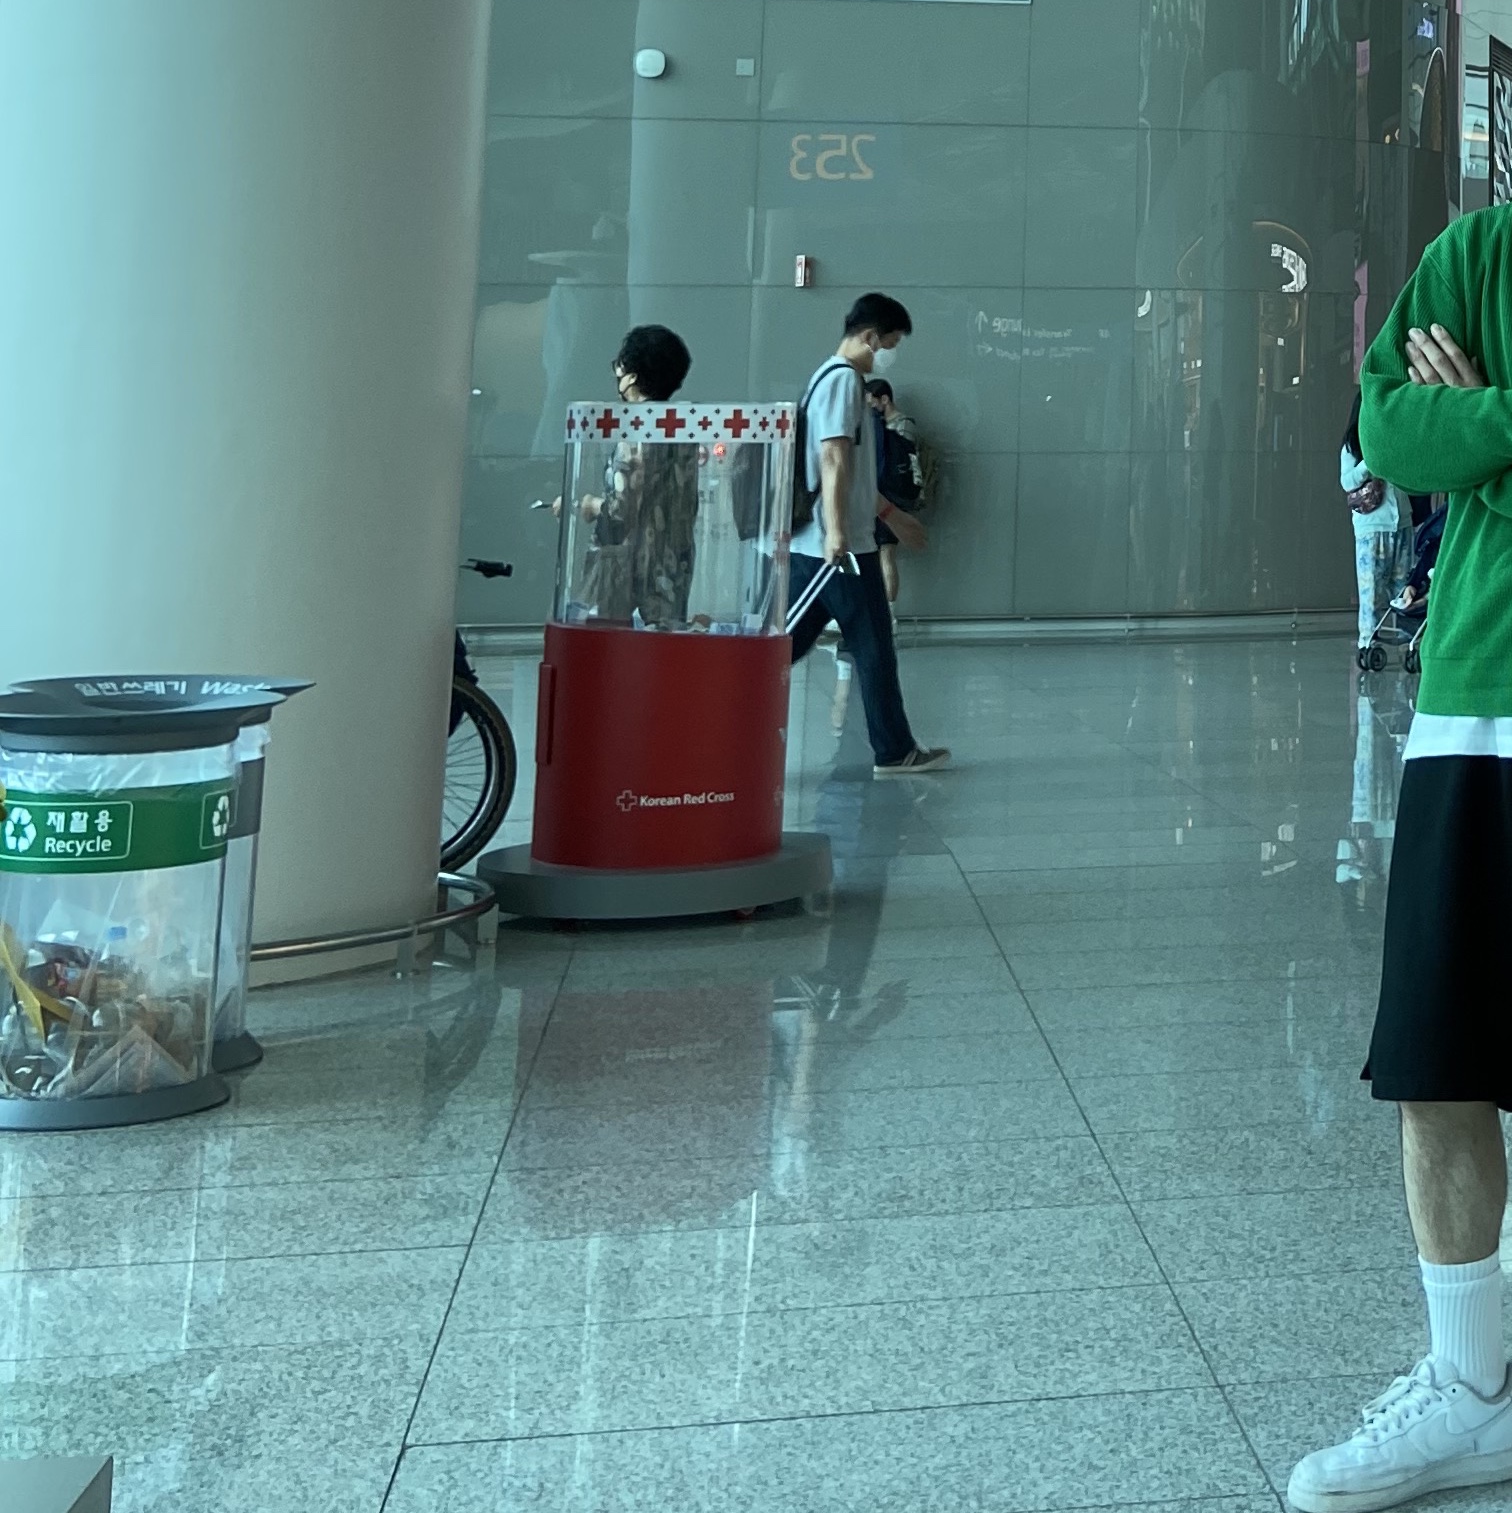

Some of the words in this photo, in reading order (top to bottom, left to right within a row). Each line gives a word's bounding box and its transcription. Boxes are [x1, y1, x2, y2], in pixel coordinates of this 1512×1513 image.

[74, 680, 187, 697] 일반쓰레기
[639, 795, 681, 807] Korean
[683, 793, 705, 805] Red
[707, 791, 735, 803] Cross
[44, 835, 112, 857] Recycle
